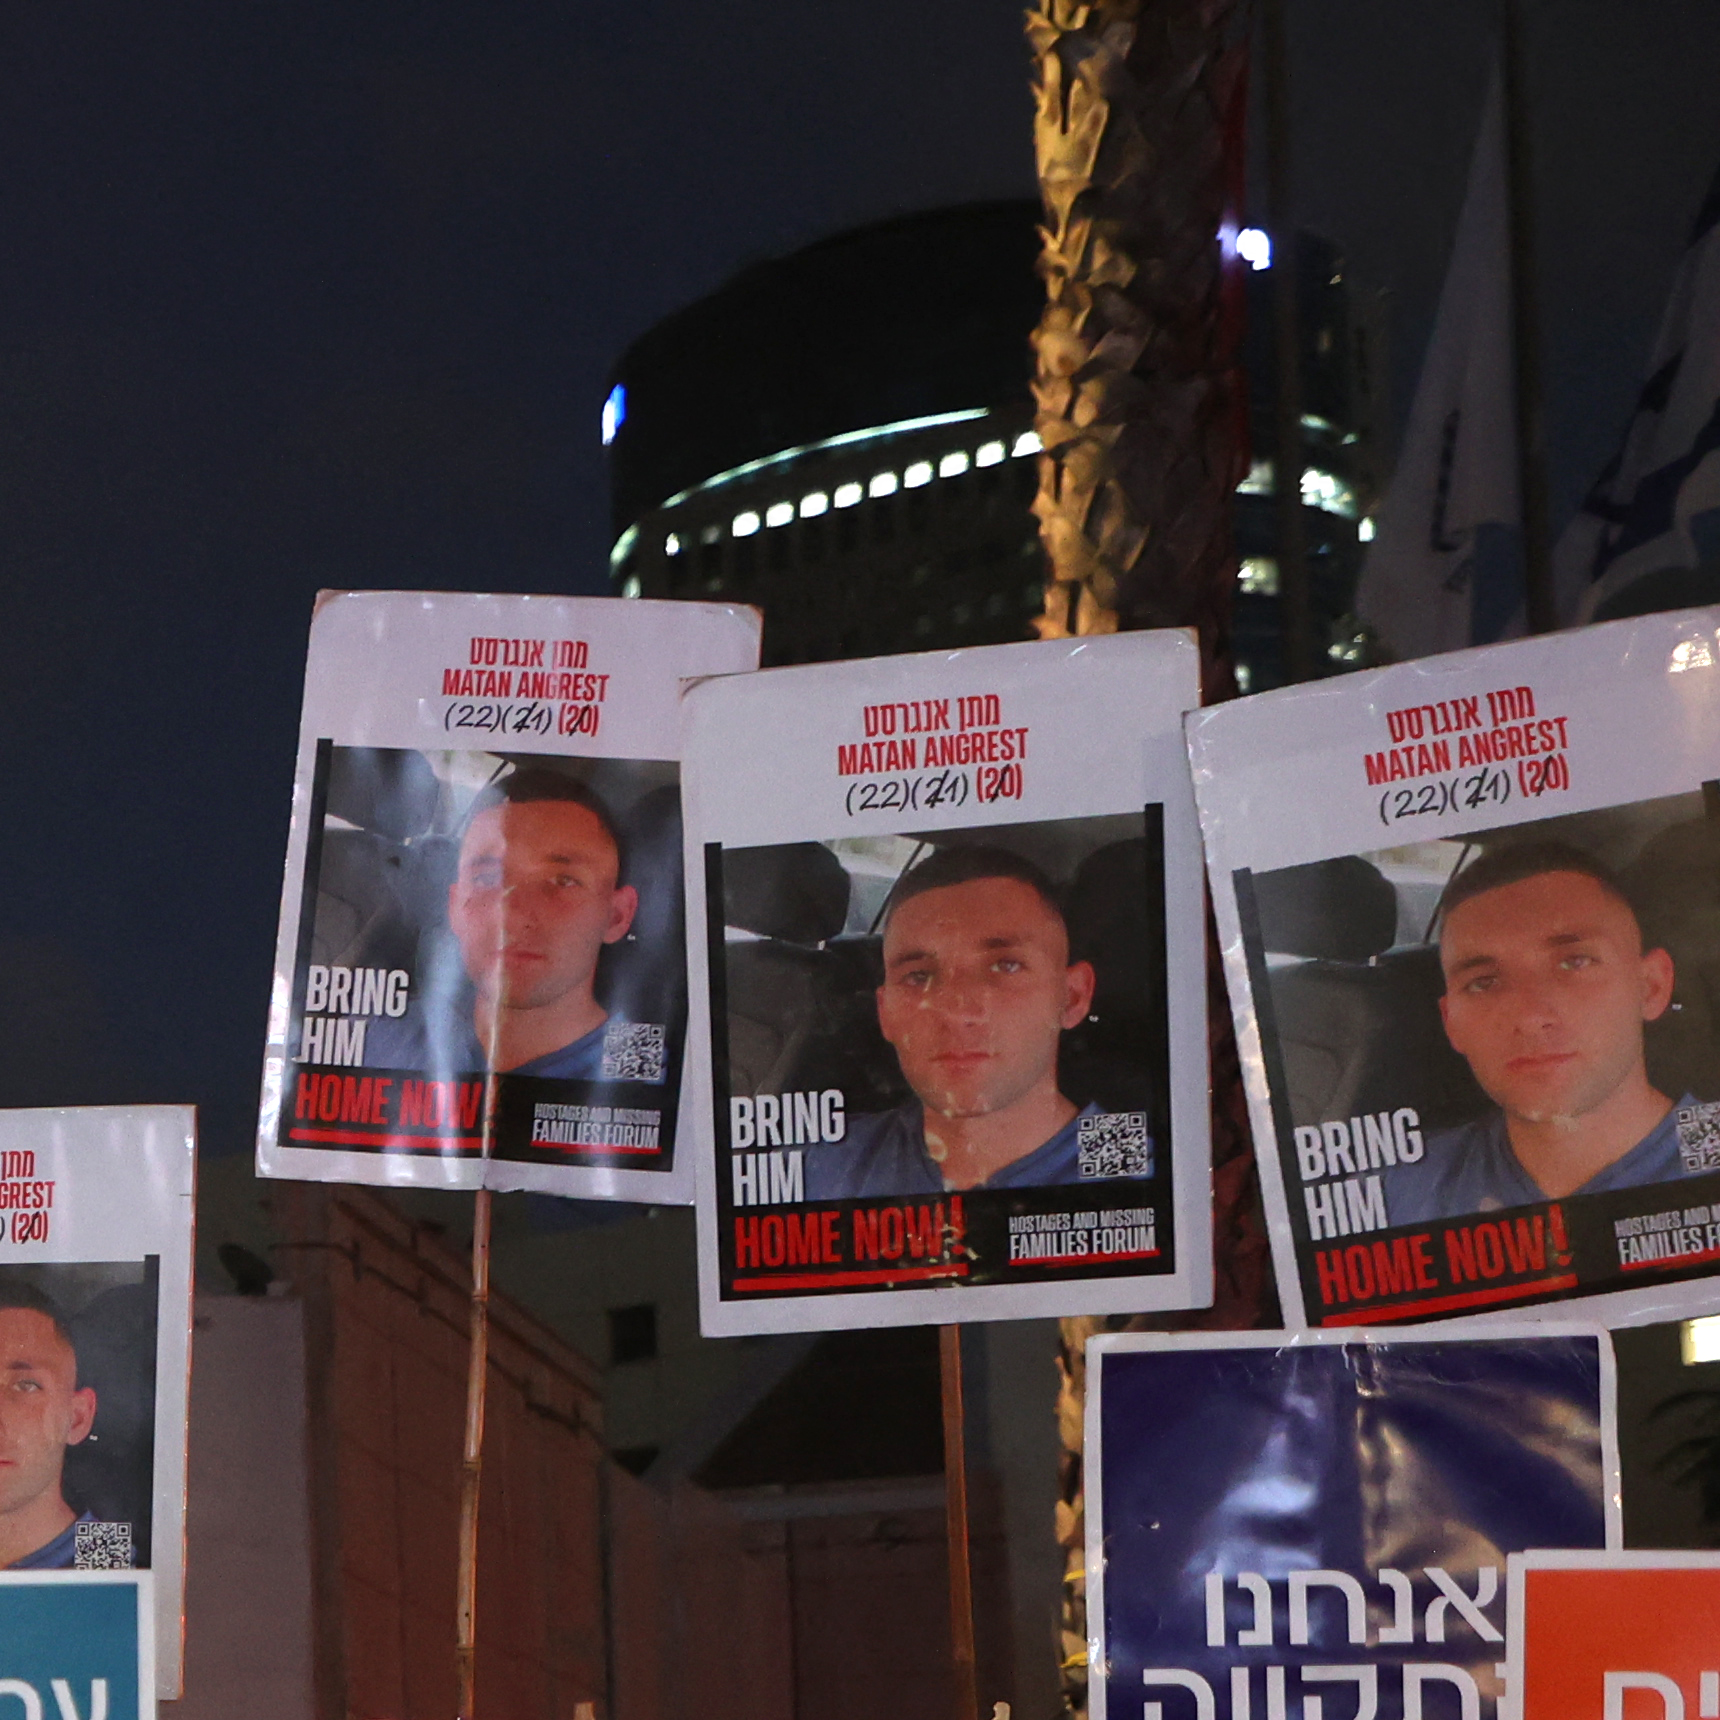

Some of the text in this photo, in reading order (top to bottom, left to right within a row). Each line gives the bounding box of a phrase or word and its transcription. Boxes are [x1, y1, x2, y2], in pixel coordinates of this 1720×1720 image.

[469, 637, 588, 670] מתן אנגרסט
[443, 668, 610, 702] MATAN ANGREST
[863, 692, 1002, 738] מתן אנגרסט
[1386, 685, 1536, 744] מתן אנגרסט
[837, 727, 1029, 776] MATAN ANGREST
[1363, 716, 1570, 787] MATAN ANGREST
[306, 965, 410, 1018] BRING
[299, 1016, 367, 1067] HIM
[294, 1070, 392, 1126] HOME
[729, 1088, 847, 1150] BRING
[532, 1119, 659, 1149] FAMILIES FORUM
[1294, 1108, 1424, 1181] BRING
[1, 1150, 36, 1183] מתן
[732, 1151, 806, 1206] HIM
[733, 1194, 968, 1269] HOME NOW!
[1008, 1207, 1155, 1233] HOSTAGES AND MISSING
[1303, 1175, 1390, 1241] HIM
[1010, 1225, 1156, 1260] FAMILIES FORUM
[1315, 1203, 1575, 1306] HOME NOW!
[1618, 1226, 1704, 1265] FAMILIES
[1204, 1566, 1505, 1648] אנחנו
